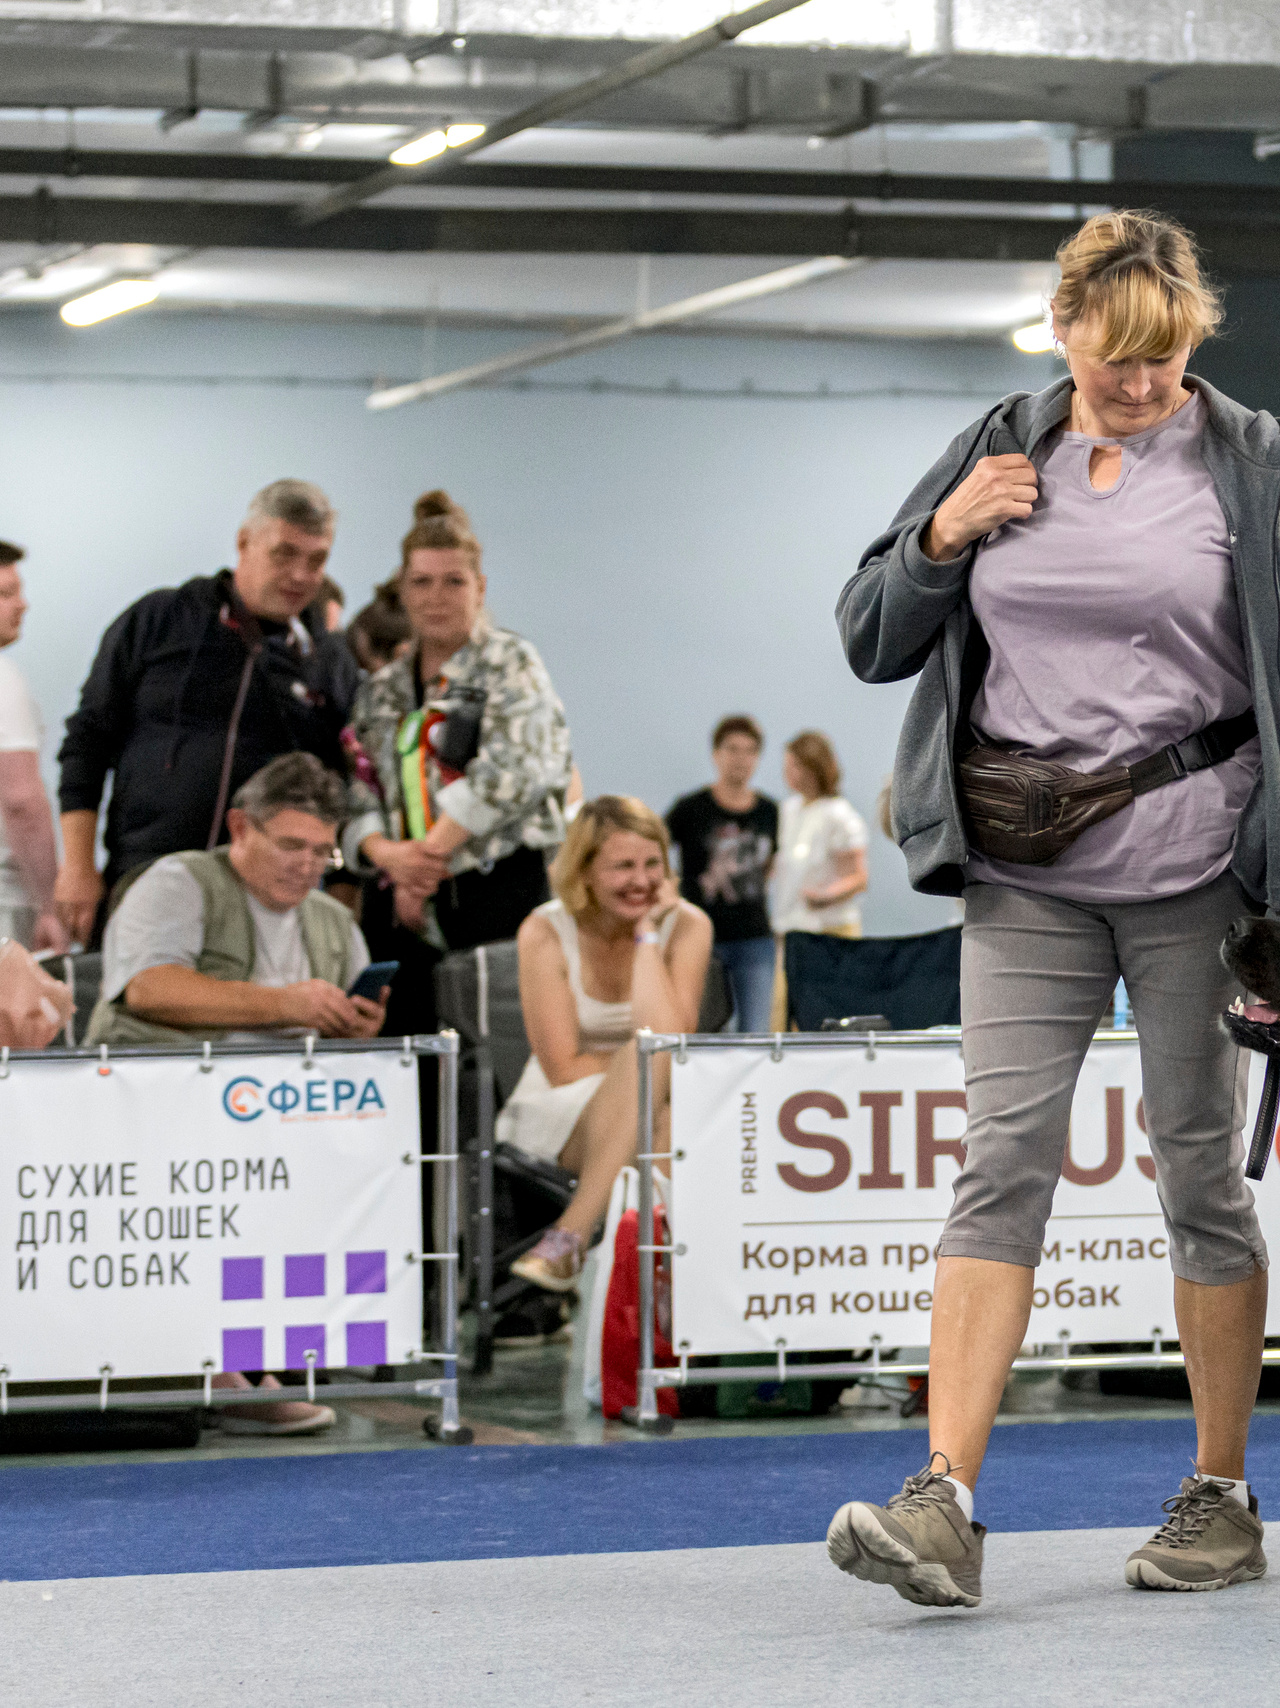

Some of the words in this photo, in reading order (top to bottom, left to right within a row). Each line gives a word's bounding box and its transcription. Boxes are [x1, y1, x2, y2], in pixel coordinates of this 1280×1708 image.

[222, 1074, 384, 1122] СФЕРА
[741, 1092, 757, 1194] PREMIUM
[18, 1162, 137, 1200] СУХИЕ
[170, 1157, 289, 1194] КОРМА
[15, 1209, 87, 1252] ДЛЯ
[120, 1204, 240, 1242] КОШЕК
[18, 1257, 37, 1291] И
[69, 1252, 191, 1290] СОБАК
[743, 1241, 867, 1276] Корма
[743, 1292, 815, 1321] для
[831, 1289, 933, 1314] коше
[1033, 1277, 1121, 1309] обак
